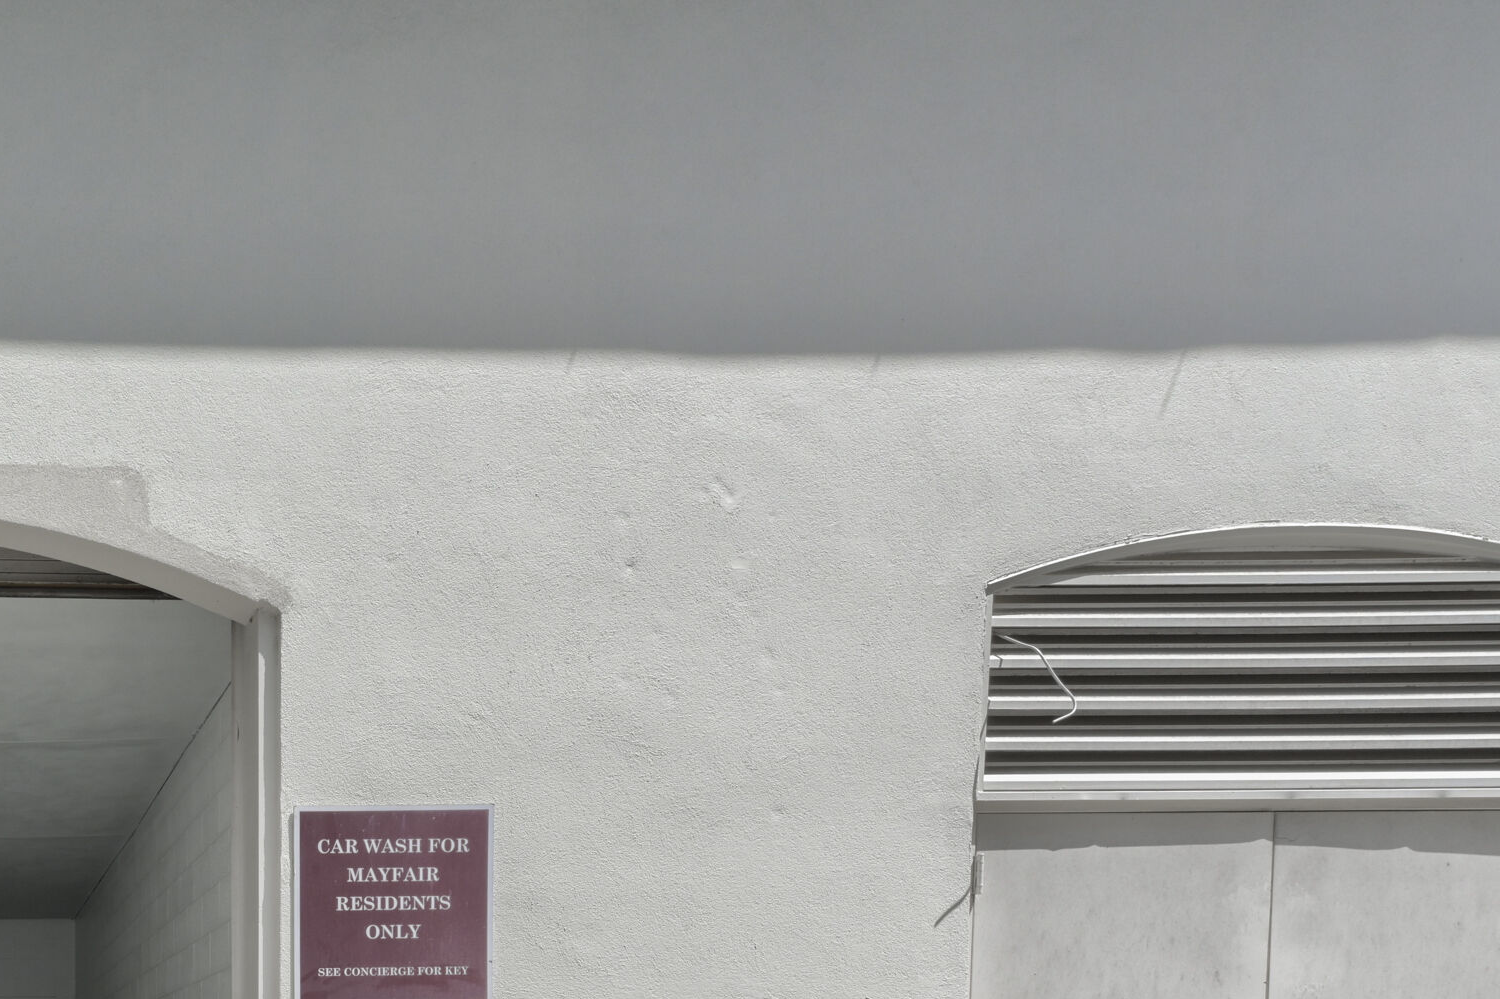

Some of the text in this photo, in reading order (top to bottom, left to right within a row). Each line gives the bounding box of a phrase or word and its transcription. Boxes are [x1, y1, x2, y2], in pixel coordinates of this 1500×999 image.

[317, 837, 470, 854] CAR WASH FOR
[347, 866, 440, 883] MAYFAIR
[336, 895, 451, 911] RESIDENTS
[365, 924, 421, 940] ONLY
[317, 965, 469, 977] SEE CONCIERGE FOR KEY
